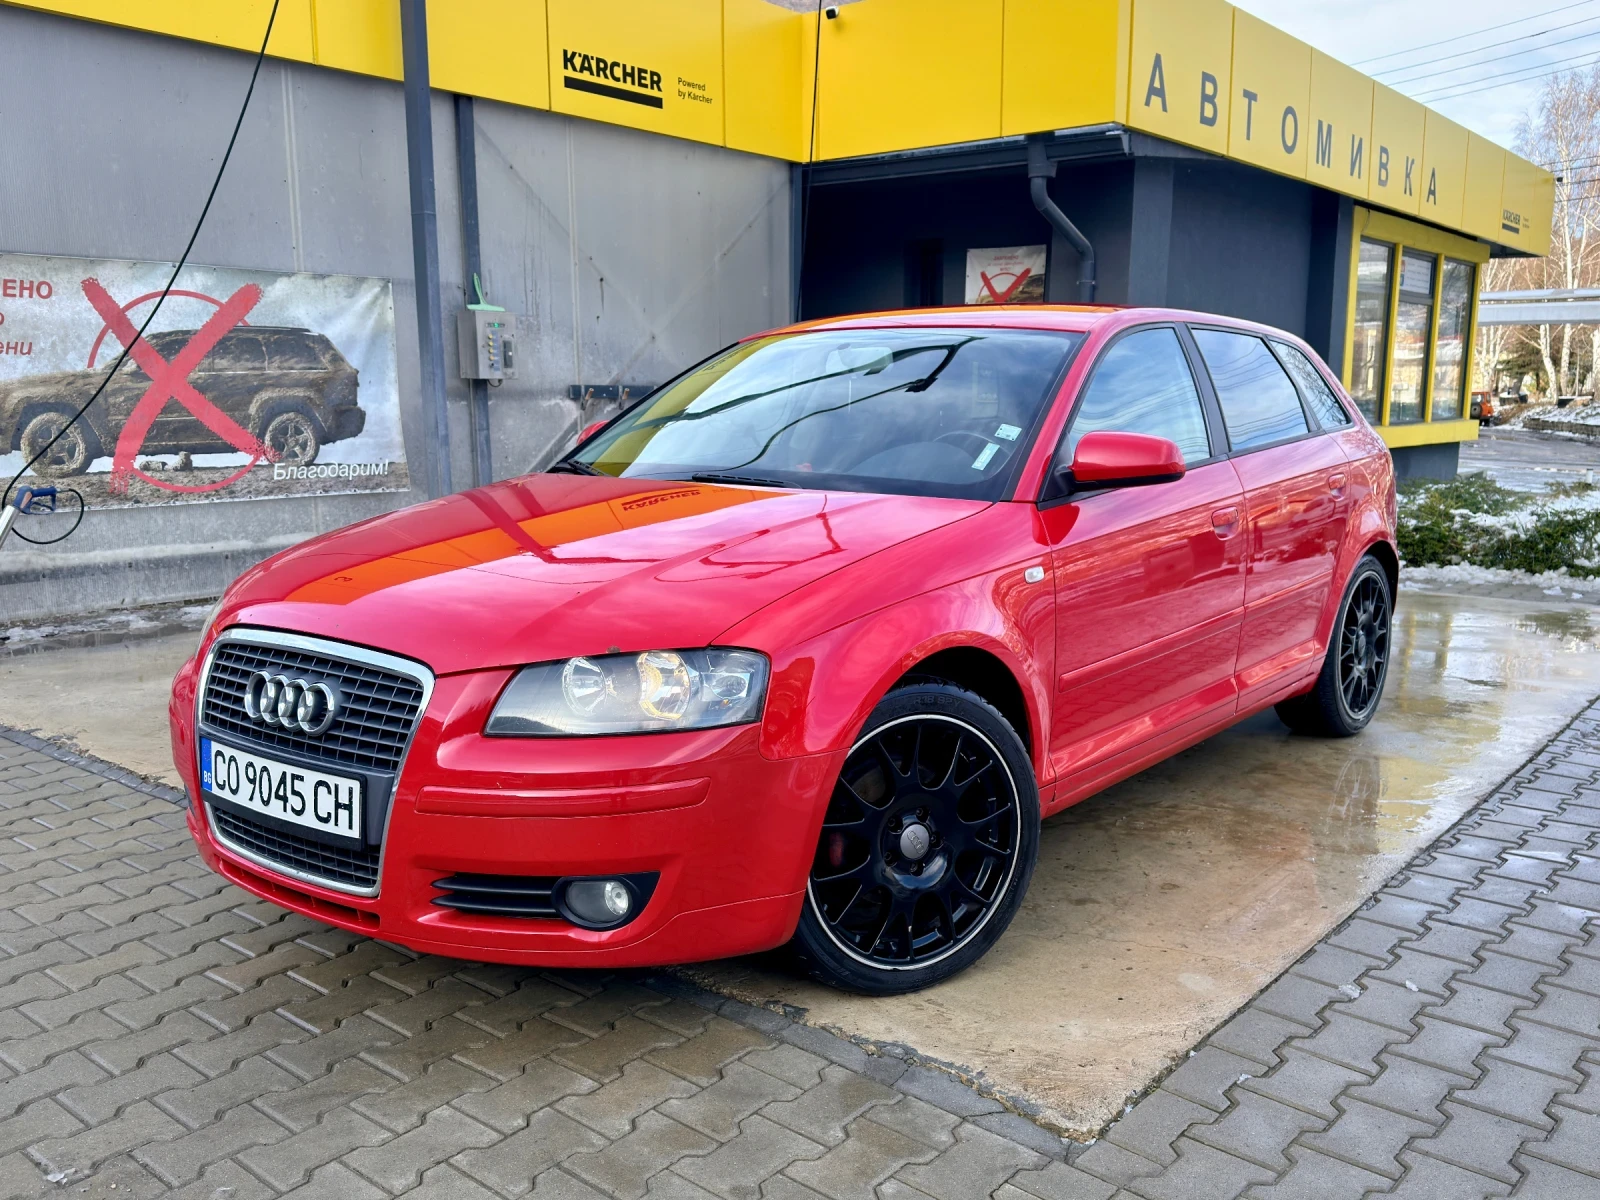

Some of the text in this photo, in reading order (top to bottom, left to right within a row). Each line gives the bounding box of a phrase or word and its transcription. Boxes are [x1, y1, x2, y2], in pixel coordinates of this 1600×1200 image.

[562, 48, 663, 92] KÄRCHER
[677, 76, 706, 92] Powered
[677, 88, 687, 100] by
[273, 459, 389, 481] Благодарим!
[203, 770, 212, 785] BG
[214, 749, 354, 831] CO 9045 CH
